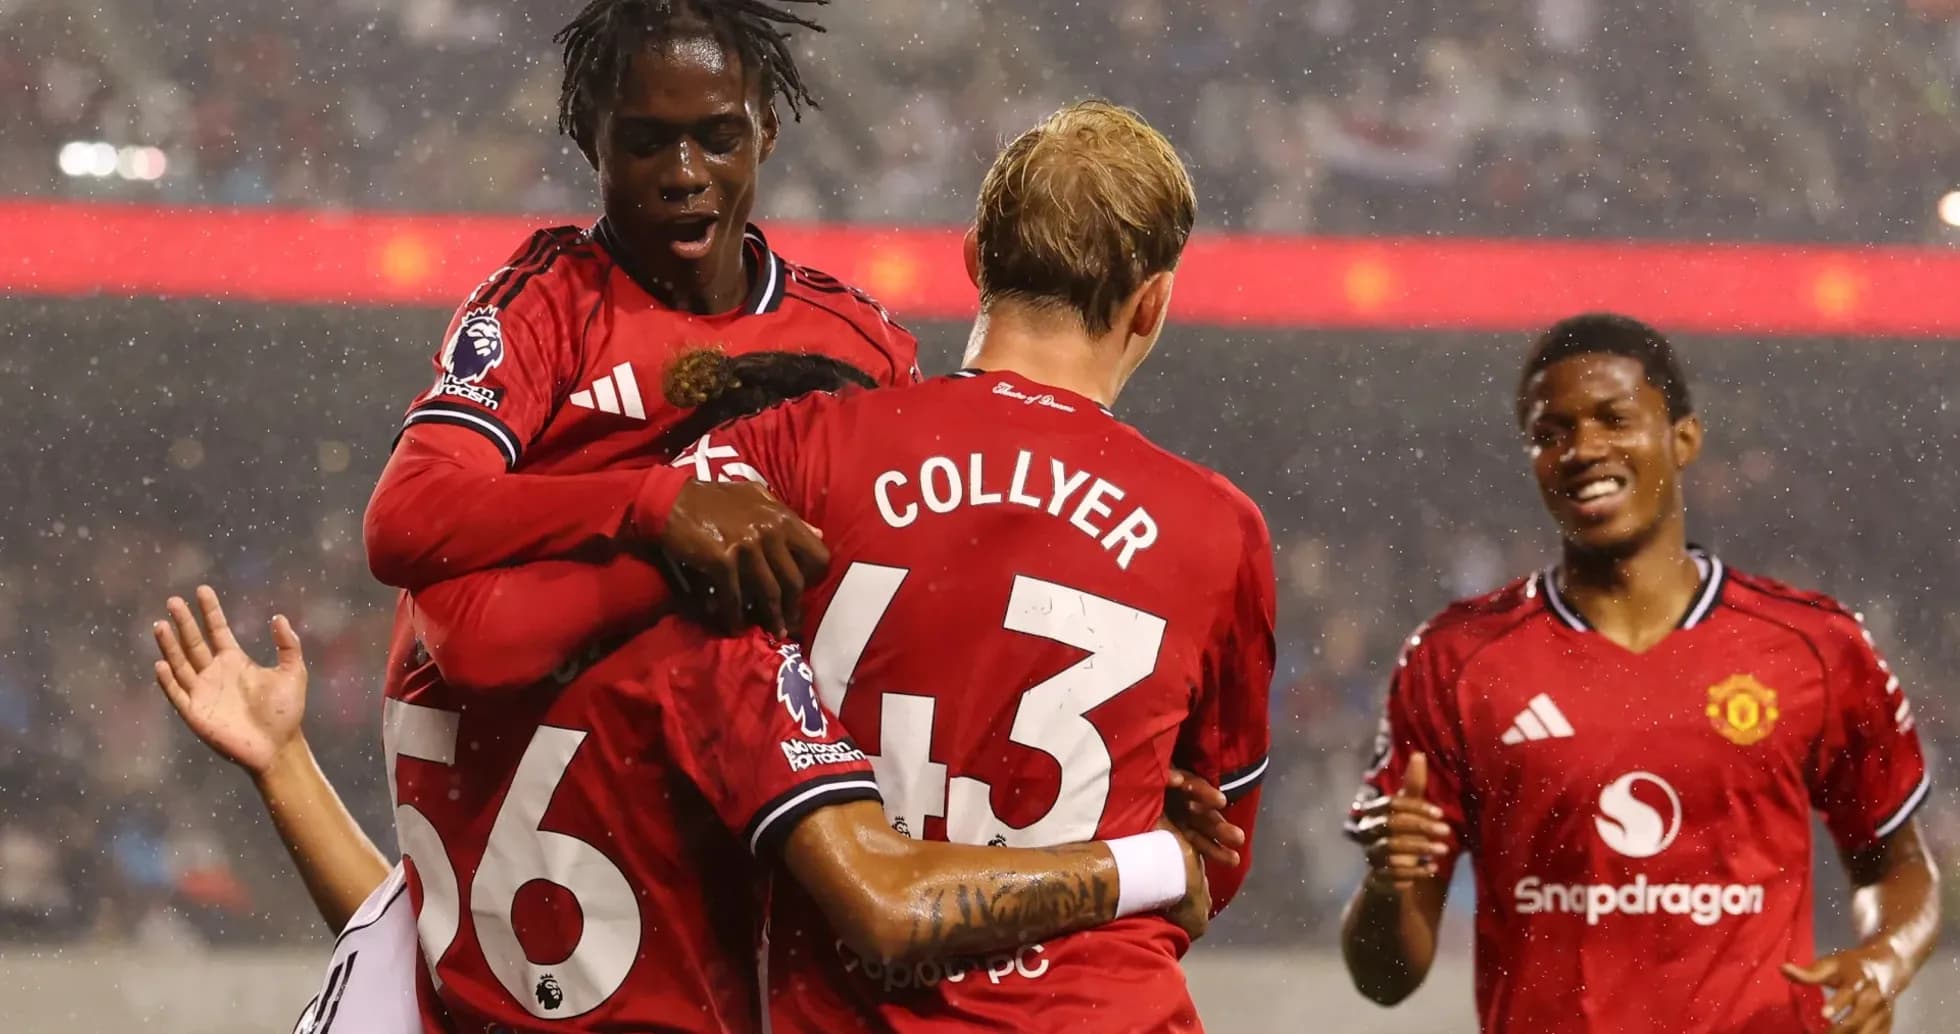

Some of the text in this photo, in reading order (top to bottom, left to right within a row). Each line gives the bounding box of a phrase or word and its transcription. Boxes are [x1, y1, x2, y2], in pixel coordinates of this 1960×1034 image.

[874, 450, 1158, 570] COLLYER
[780, 739, 851, 756] No room
[810, 561, 1167, 848] 43
[382, 696, 643, 1019] 56
[1513, 873, 1765, 926] Snapdragon
